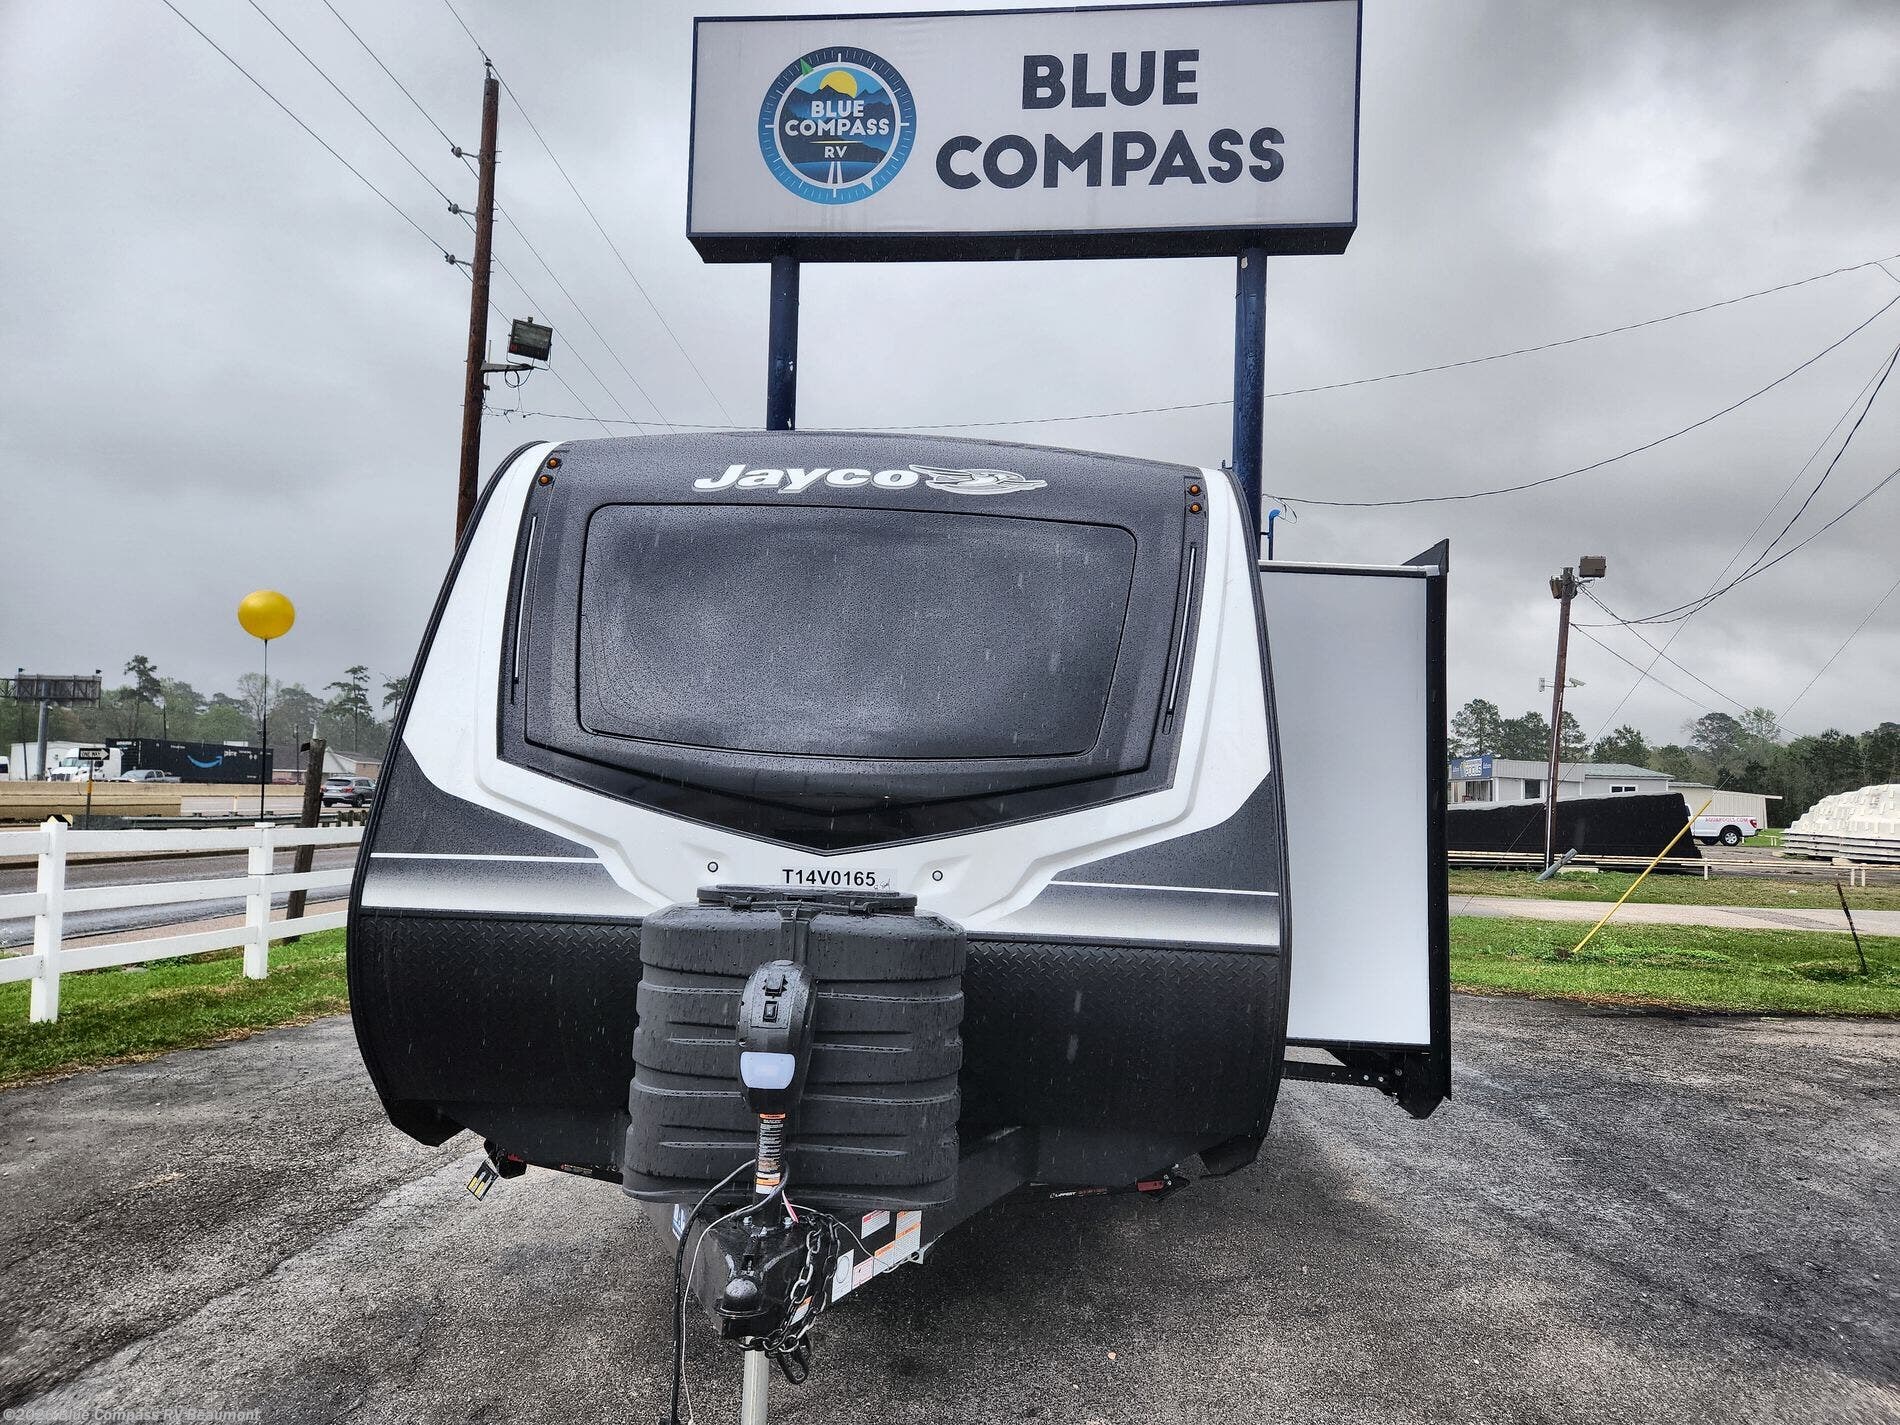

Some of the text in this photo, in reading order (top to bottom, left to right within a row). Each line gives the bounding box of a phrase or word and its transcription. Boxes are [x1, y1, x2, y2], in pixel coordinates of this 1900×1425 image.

[1022, 49, 1200, 110] BLUE
[811, 100, 865, 118] BLUE
[784, 118, 890, 137] COMPASS
[824, 146, 848, 159] RV
[936, 127, 1285, 190] COMPASS
[692, 463, 921, 494] Jayco
[782, 868, 876, 887] T14V0165
